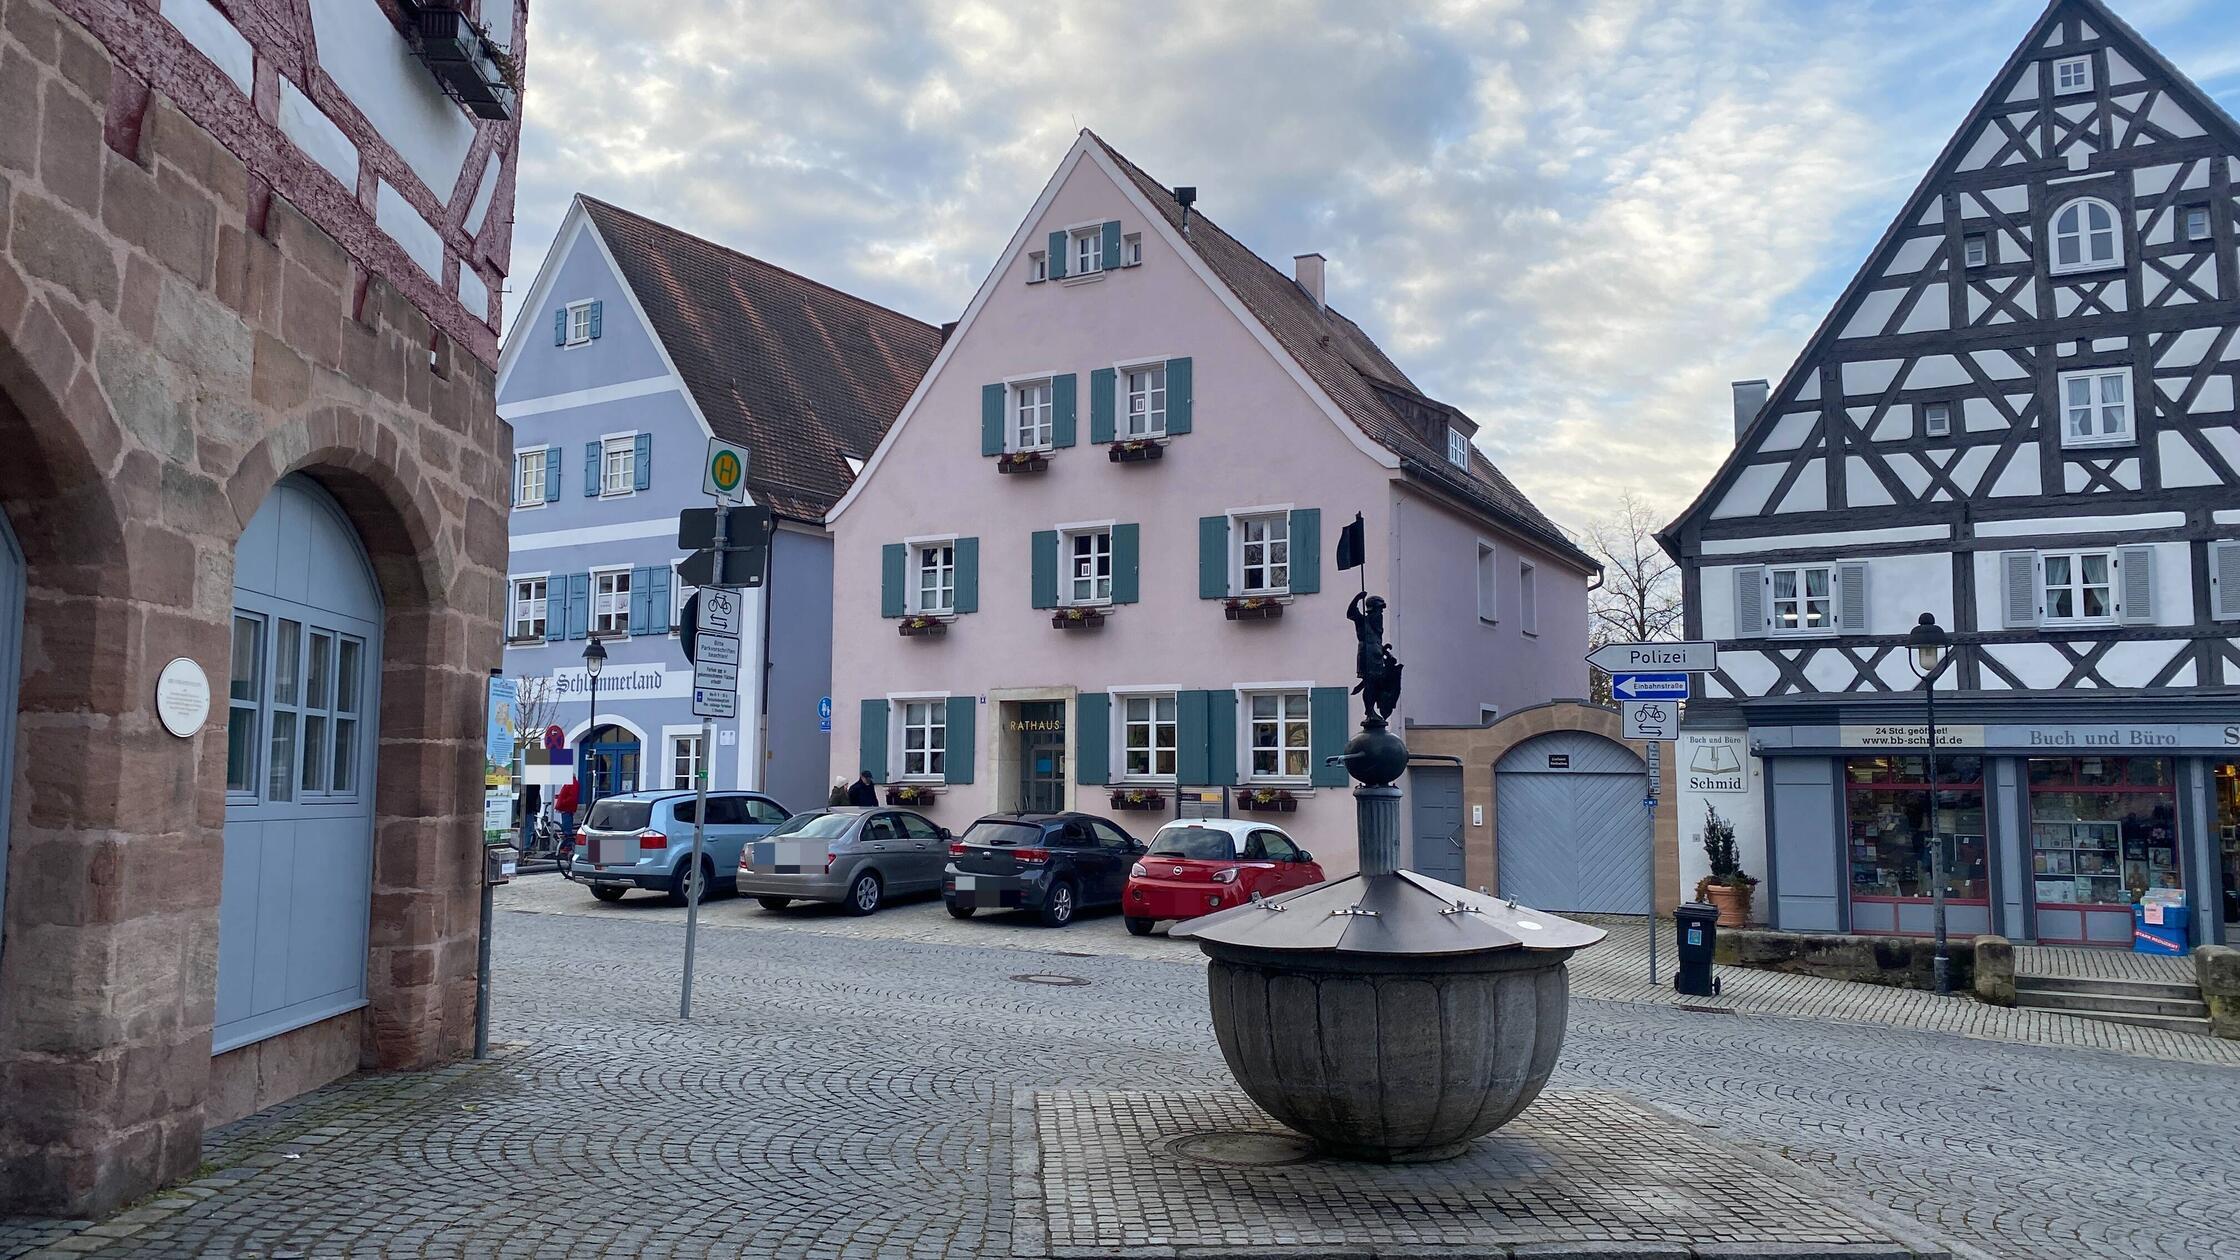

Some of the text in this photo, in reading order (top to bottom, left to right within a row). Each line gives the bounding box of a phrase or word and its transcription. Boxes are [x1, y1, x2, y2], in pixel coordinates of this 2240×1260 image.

[719, 457, 734, 484] H
[1630, 650, 1687, 664] Polizei
[1633, 682, 1684, 690] Einbahnstraße
[1010, 720, 1060, 730] RATHAUS
[1875, 727, 1948, 736] 24 Std. geöfet!
[1690, 736, 1741, 744] Buch und Büro
[1862, 736, 1963, 745] www.bb-schid.de
[2030, 730, 2076, 745] Buch
[2085, 730, 2120, 745] und
[2129, 730, 2176, 745] Büro
[1690, 777, 1741, 790] Schmid
